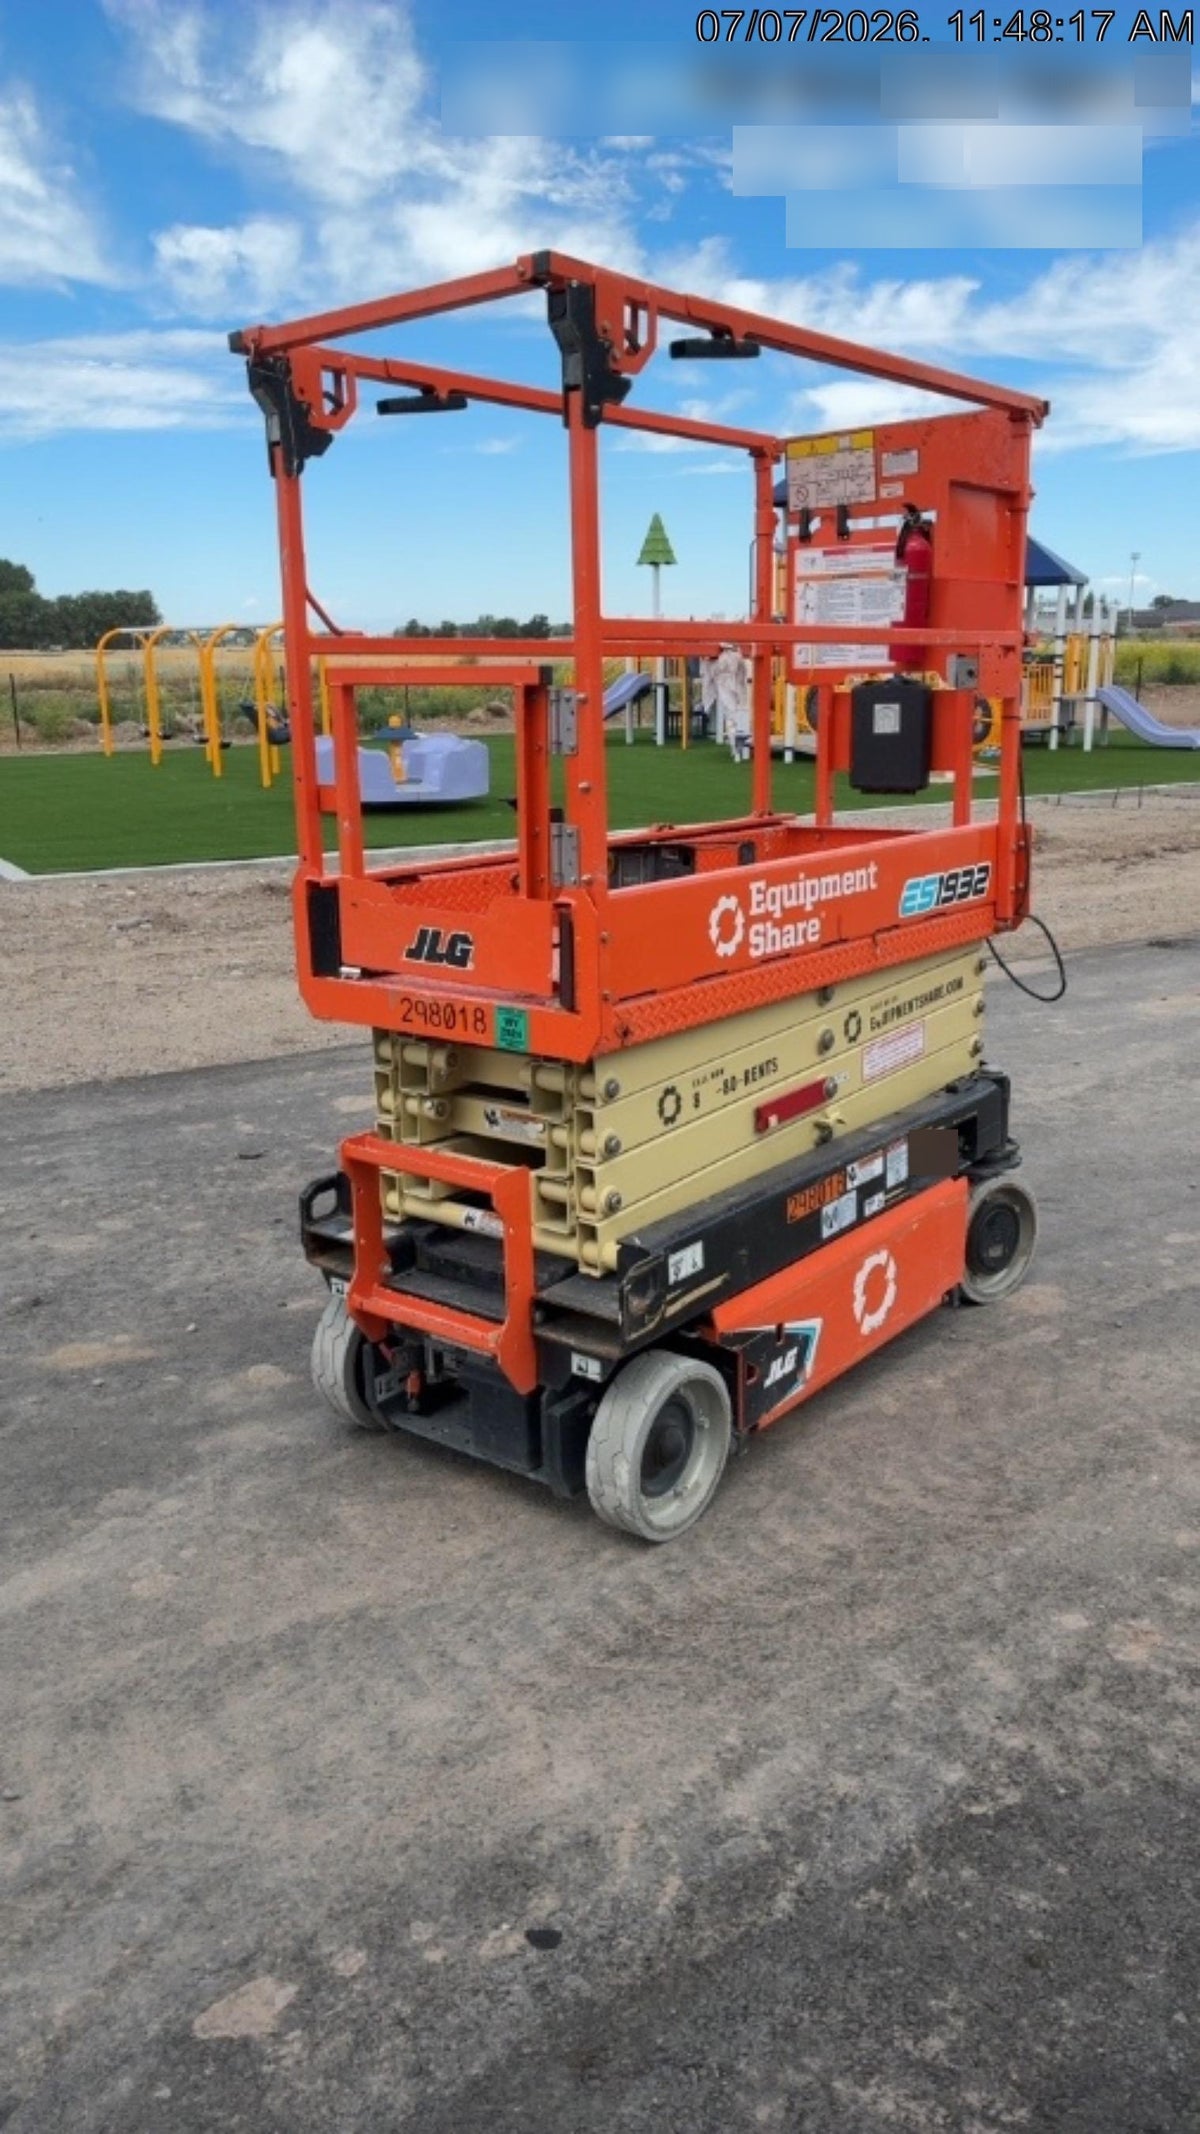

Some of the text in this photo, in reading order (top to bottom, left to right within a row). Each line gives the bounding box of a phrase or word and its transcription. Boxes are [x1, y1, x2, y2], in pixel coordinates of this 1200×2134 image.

[749, 861, 878, 918] Equipment
[900, 862, 991, 918] ES1932
[404, 927, 474, 969] JLG
[749, 917, 821, 958] Share
[400, 997, 487, 1034] 298018
[763, 1346, 798, 1389] JLG
